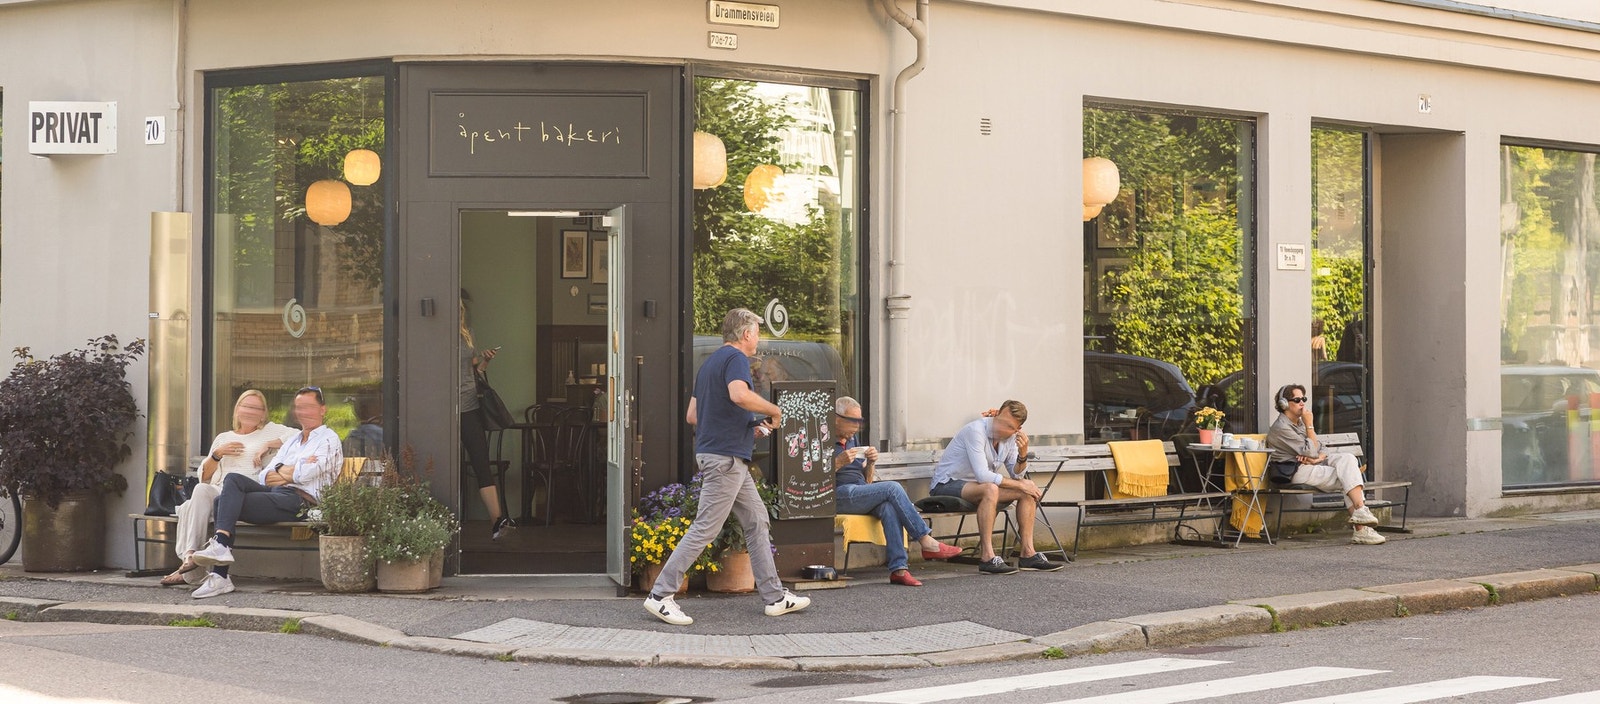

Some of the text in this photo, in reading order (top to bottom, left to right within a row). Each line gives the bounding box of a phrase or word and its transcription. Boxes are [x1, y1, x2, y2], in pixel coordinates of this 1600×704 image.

[715, 3, 775, 23] Drammensveien
[31, 111, 103, 144] PRIVAT
[145, 119, 160, 141] 70
[458, 112, 620, 155] åpent bakeri
